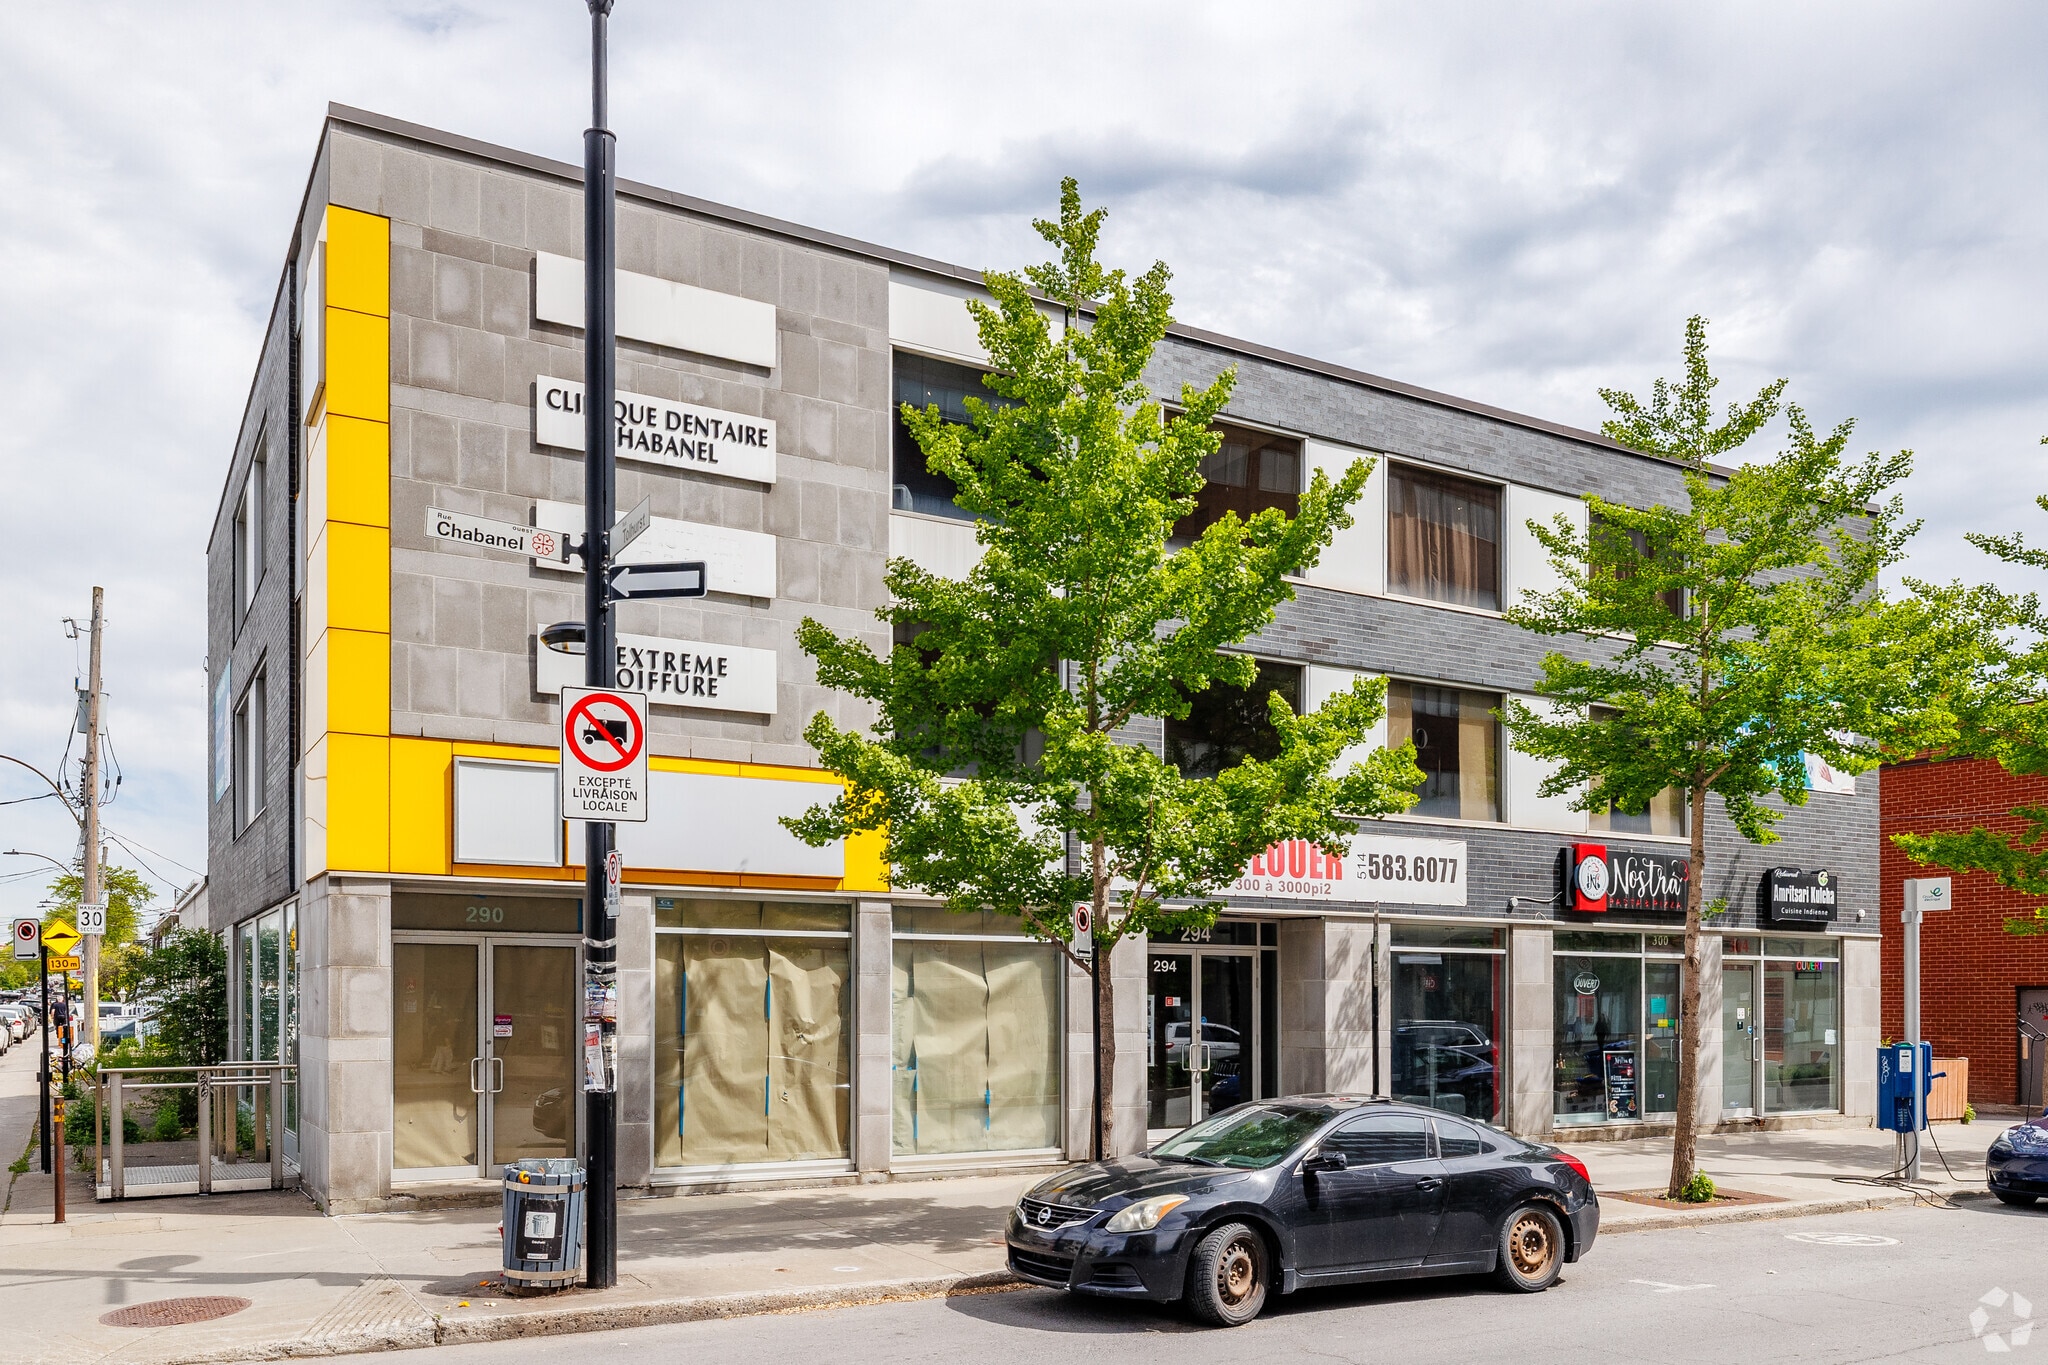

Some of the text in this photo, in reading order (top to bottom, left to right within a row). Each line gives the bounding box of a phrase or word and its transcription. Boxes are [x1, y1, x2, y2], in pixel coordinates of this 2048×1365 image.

[546, 388, 768, 447] CLIQUE DENTAIRE
[614, 425, 718, 464] HABANEL
[437, 512, 452, 521] Rue
[437, 521, 523, 550] Chabanel
[512, 526, 533, 534] ouest
[616, 646, 728, 677] EXTREME
[616, 667, 718, 697] OIFFURE
[579, 776, 631, 789] EXCEPTÉ
[573, 788, 638, 801] LIVRAISON
[583, 801, 628, 812] LOCALE
[1252, 840, 1342, 880] LOUER
[1357, 853, 1366, 879] 514
[1368, 854, 1458, 883] 583.6077
[1235, 879, 1331, 896] 300 à 3000pi2
[1773, 884, 1835, 904] Amritsari Kulcha
[80, 911, 102, 926] 30
[466, 906, 504, 923] 290
[1803, 908, 1828, 916] Indienne
[1180, 925, 1211, 942] 294
[1652, 936, 1669, 946] 300
[51, 960, 69, 968] 130
[1153, 960, 1177, 972] 294
[1796, 961, 1823, 970] OUVERT
[1576, 979, 1598, 989] OUVERT
